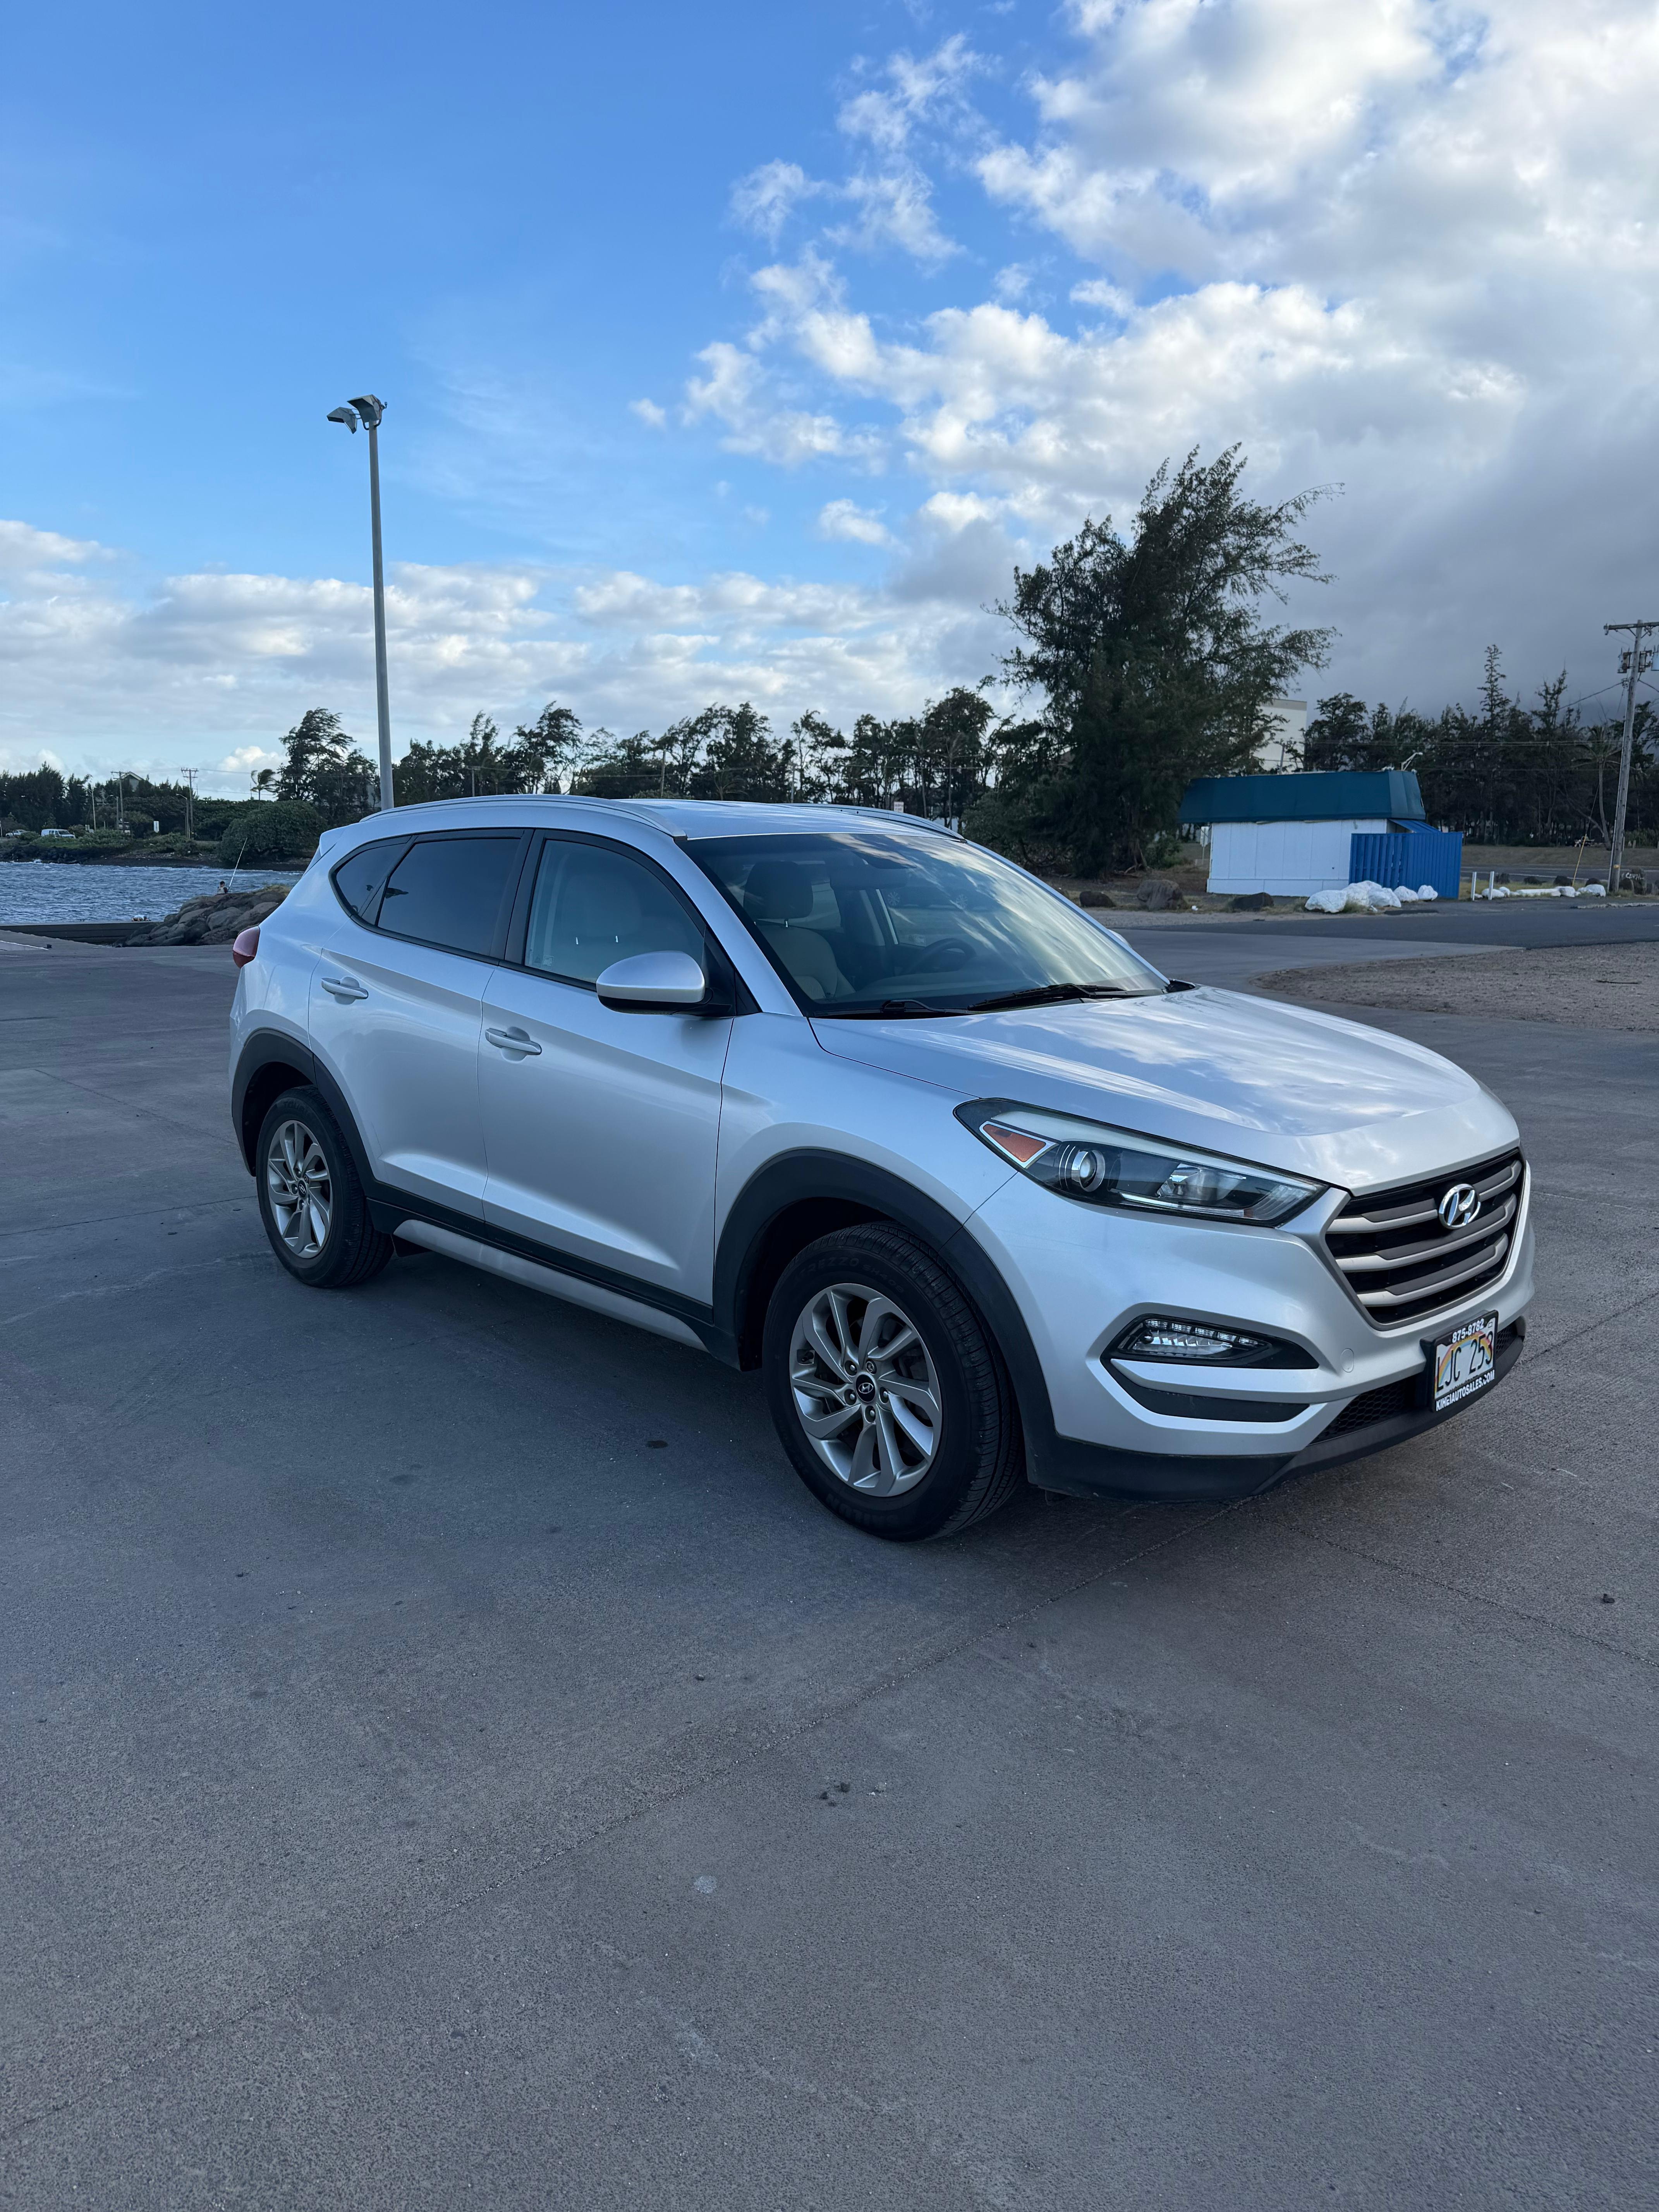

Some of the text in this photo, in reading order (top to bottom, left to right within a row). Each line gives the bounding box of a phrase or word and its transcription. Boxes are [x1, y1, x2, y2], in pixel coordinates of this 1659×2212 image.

[1452, 1318, 1484, 1343] 875-8782
[1436, 1331, 1493, 1391] LJC 253
[1436, 1370, 1495, 1411] KIHEIAUTOSALES.COM
